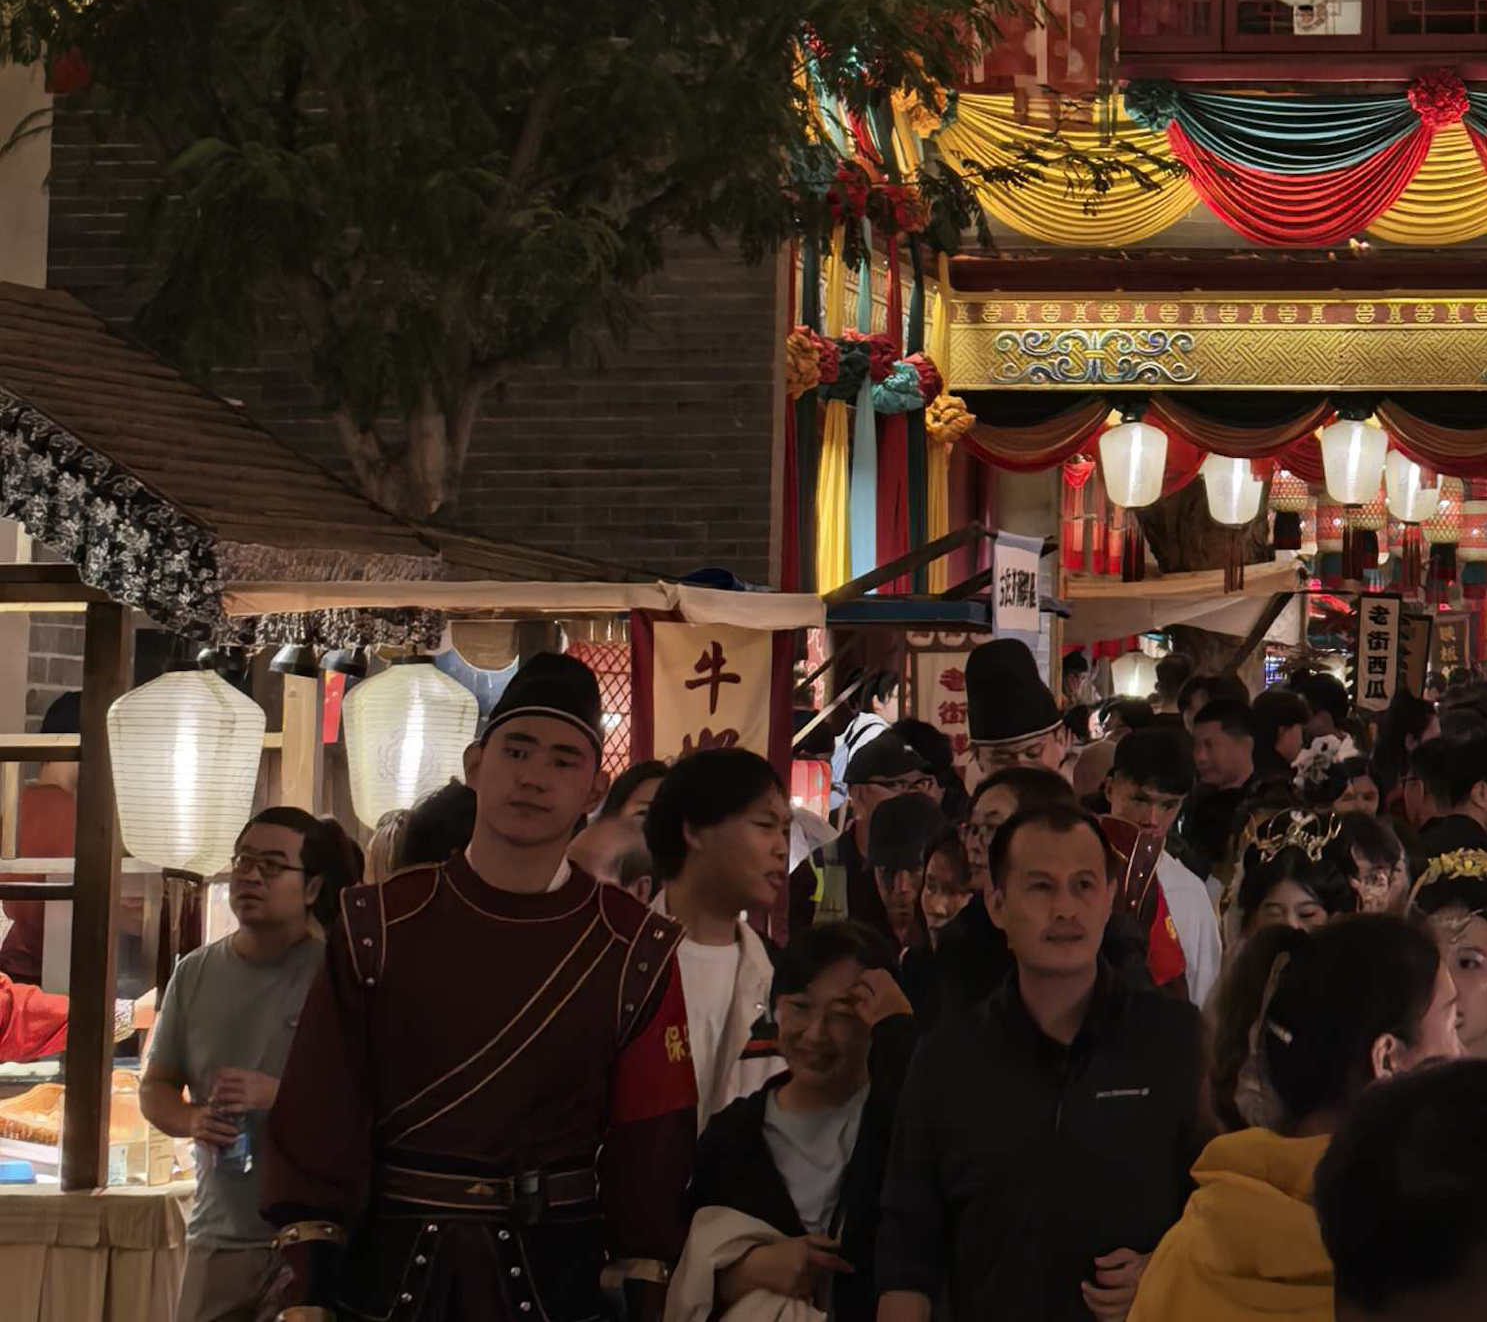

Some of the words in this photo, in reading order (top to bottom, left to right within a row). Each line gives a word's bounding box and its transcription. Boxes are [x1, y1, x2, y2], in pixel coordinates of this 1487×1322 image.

[683, 640, 742, 750] 牛
[1365, 605, 1390, 698] 老街西瓜
[665, 1025, 688, 1063] 保
